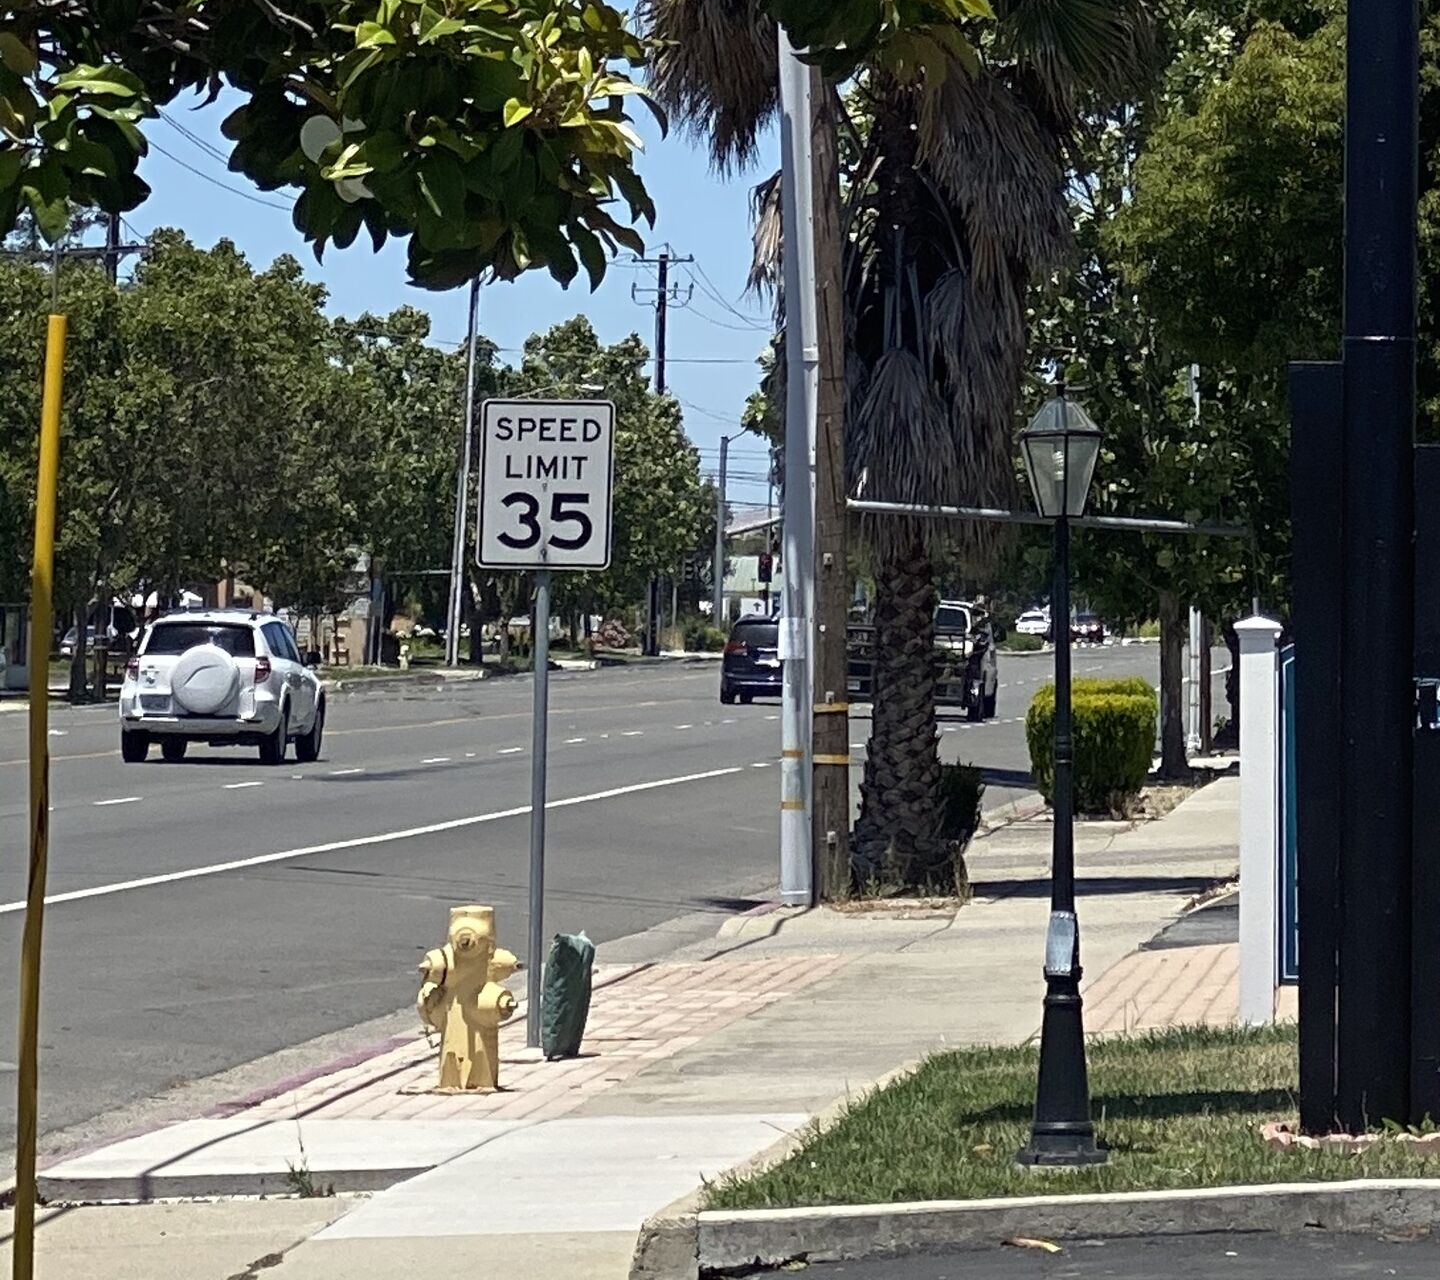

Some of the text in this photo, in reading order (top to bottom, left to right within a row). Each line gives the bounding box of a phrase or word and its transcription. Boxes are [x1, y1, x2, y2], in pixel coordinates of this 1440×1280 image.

[495, 417, 601, 442] SPEED
[505, 455, 588, 480] LIMIT
[497, 492, 592, 550] 35
